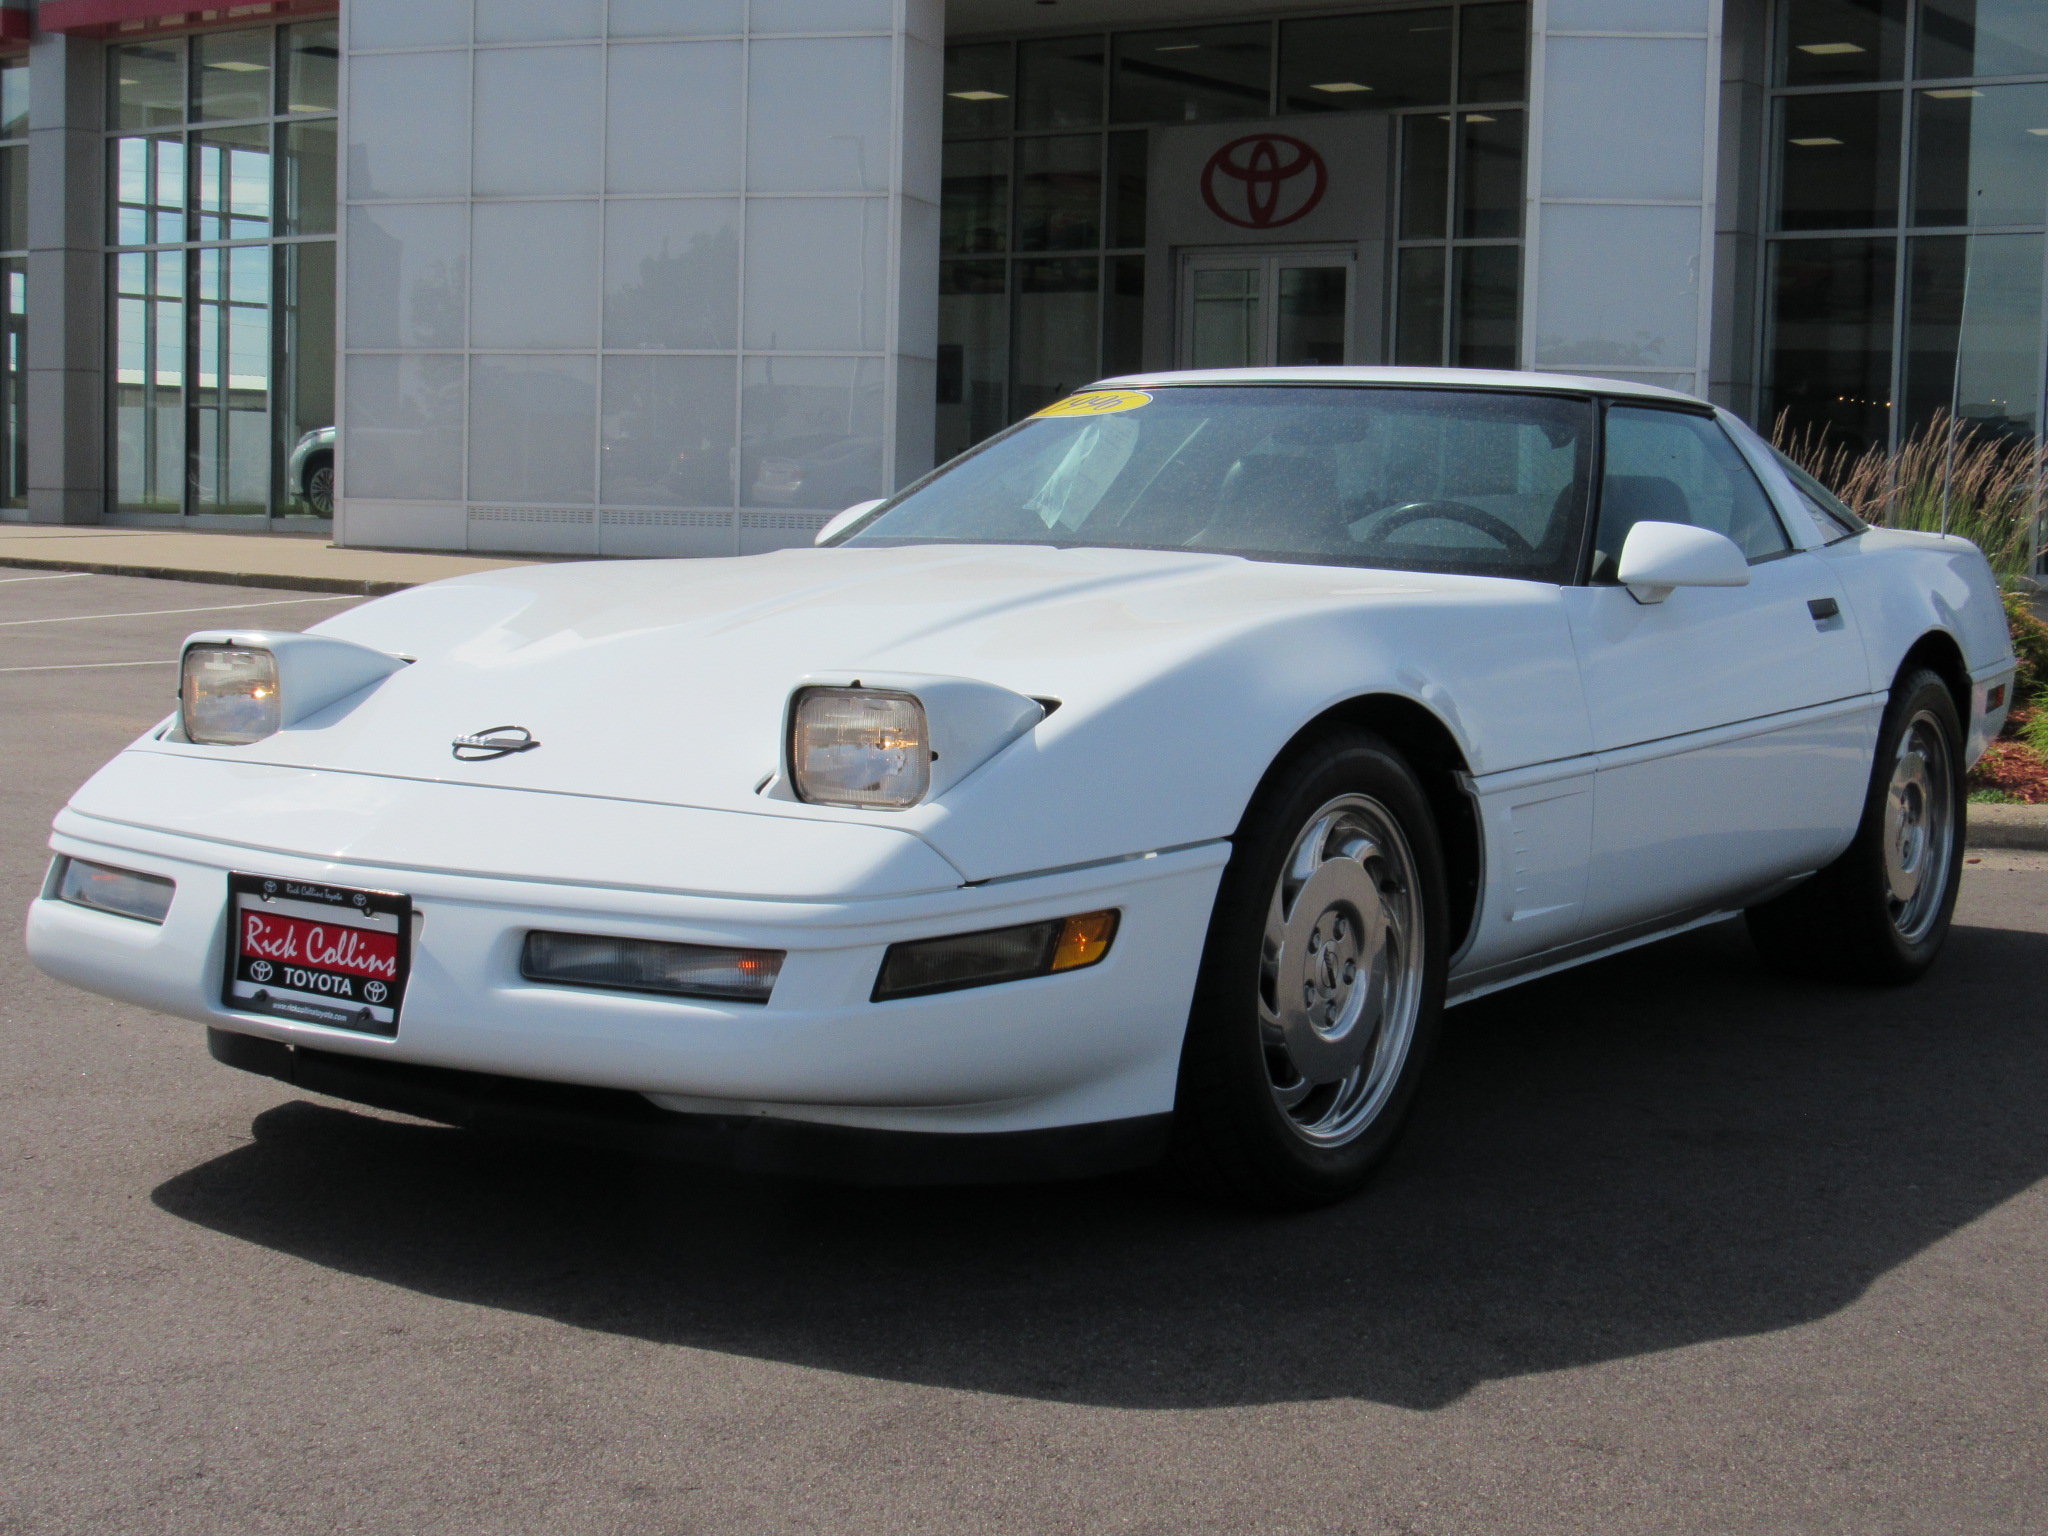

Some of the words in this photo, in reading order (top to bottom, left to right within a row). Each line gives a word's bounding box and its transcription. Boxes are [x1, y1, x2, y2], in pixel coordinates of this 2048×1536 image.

[286, 883, 300, 895] Rick
[301, 887, 325, 897] Collins
[325, 888, 343, 902] Toyota
[247, 915, 297, 958] Rick
[306, 927, 397, 977] Collins
[284, 967, 353, 996] TOYOTA
